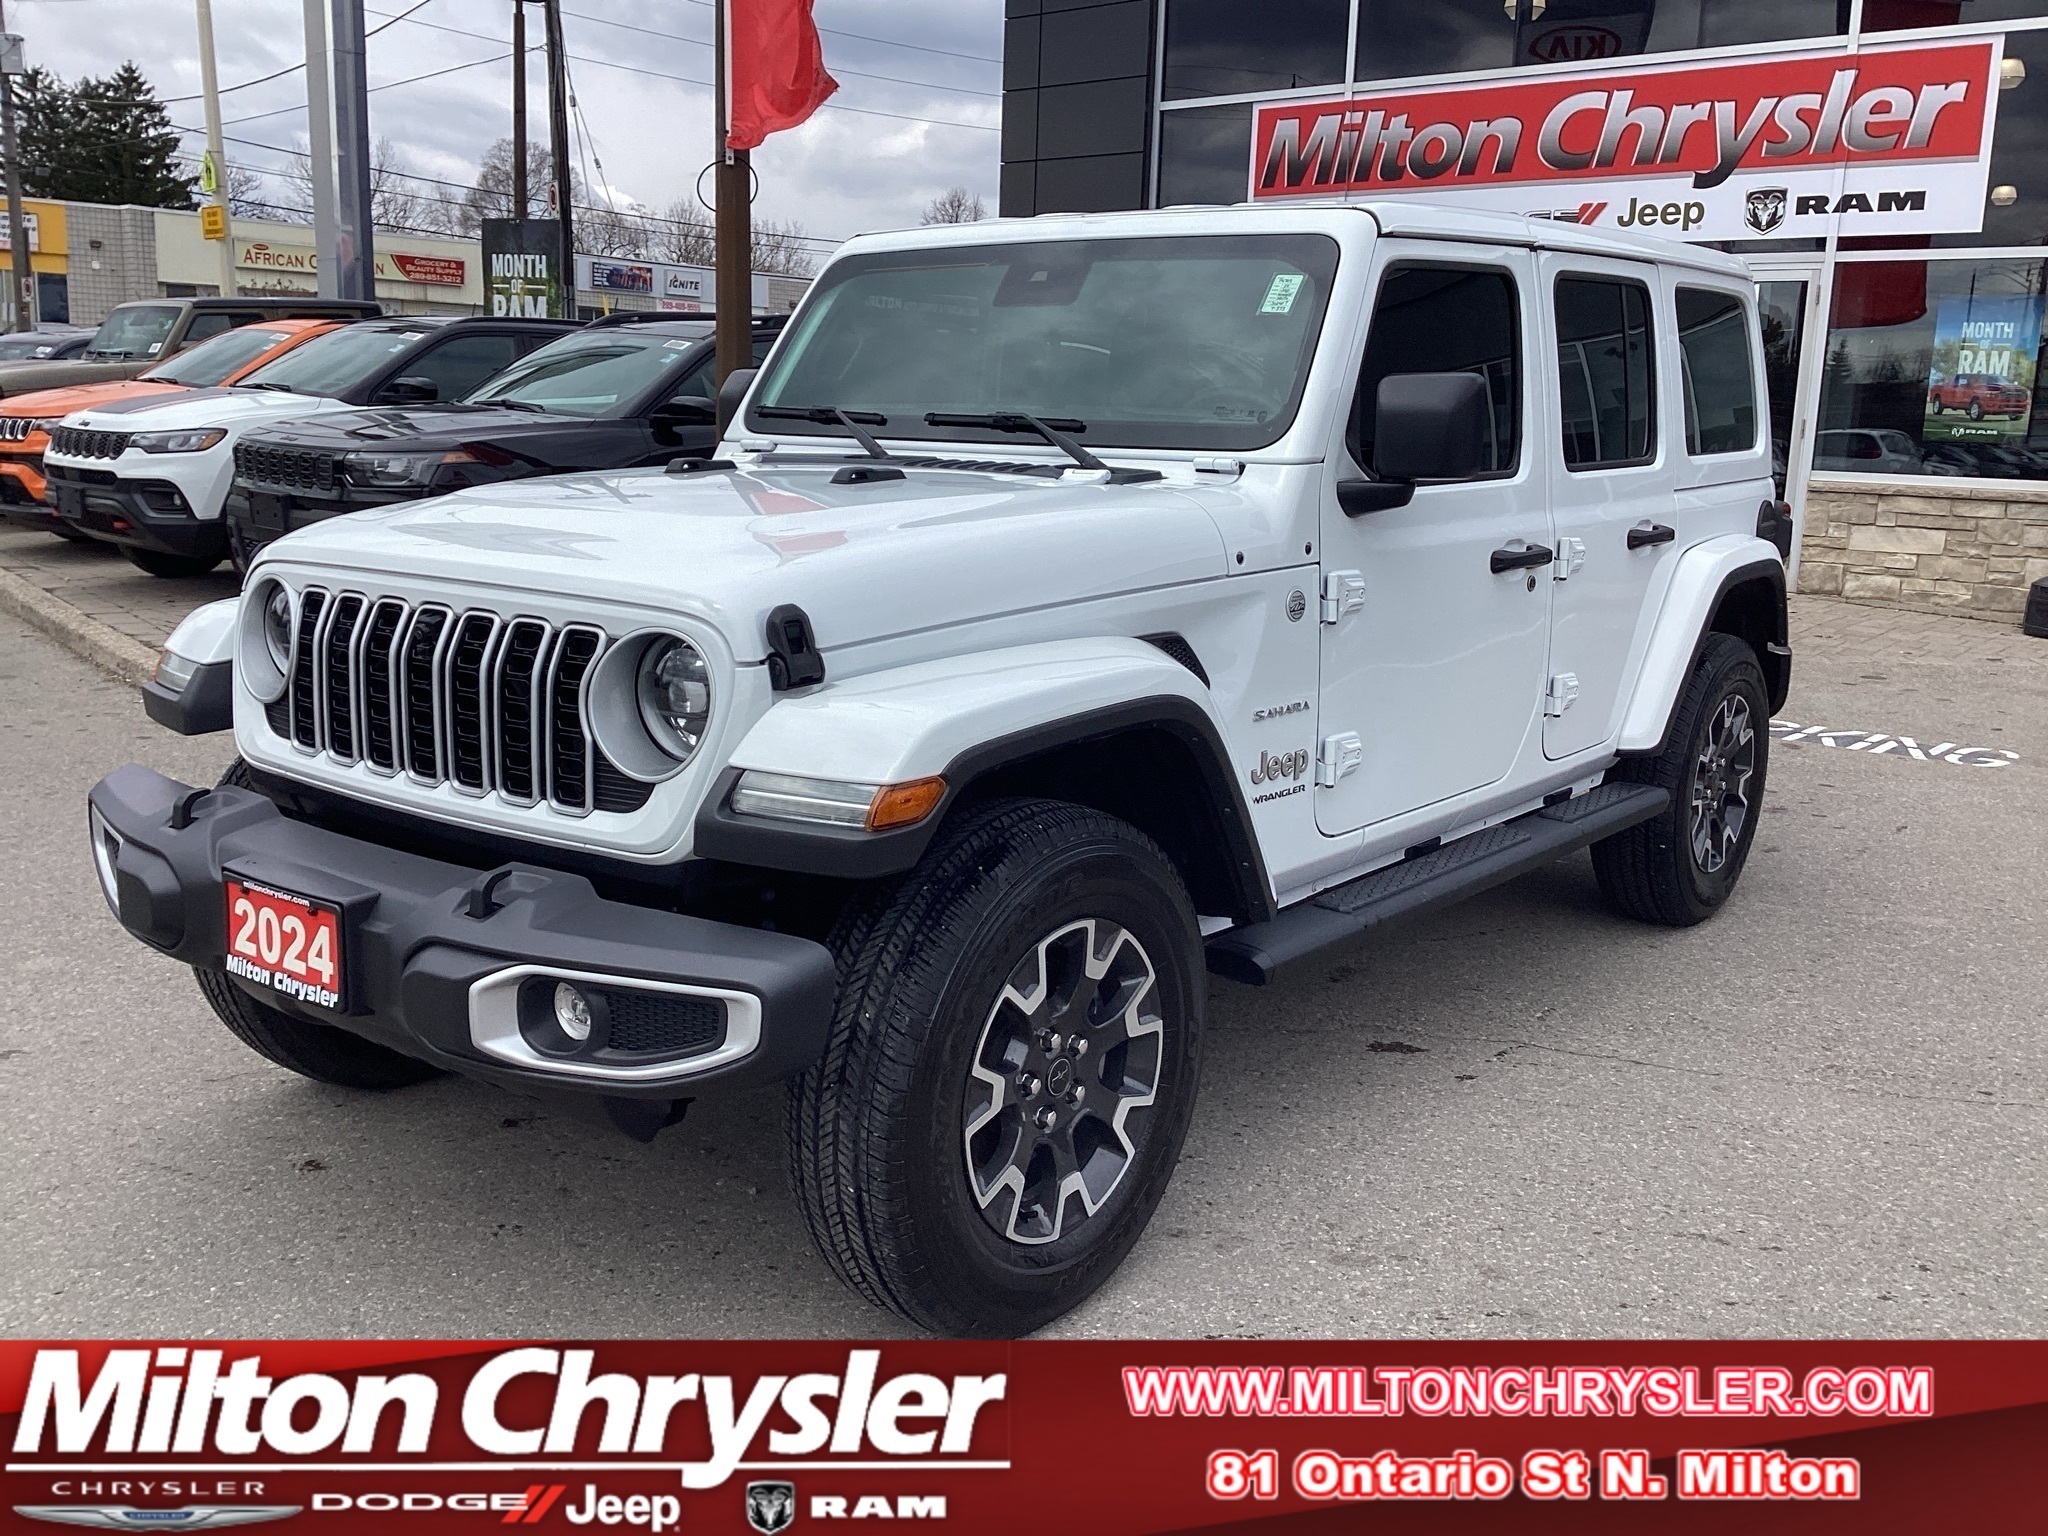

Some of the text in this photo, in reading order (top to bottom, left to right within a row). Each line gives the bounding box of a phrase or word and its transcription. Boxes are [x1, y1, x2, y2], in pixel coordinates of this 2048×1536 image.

[1260, 68, 1968, 189] Milton Chrysler
[1617, 197, 1705, 231] Jeep
[1795, 190, 1927, 215] RAM
[243, 248, 304, 269] AFRICAN
[405, 264, 462, 275] BEAUTY SUPPLY
[414, 258, 449, 267] GROCERY
[492, 253, 547, 278] MONTH
[510, 278, 523, 293] OF
[668, 277, 700, 291] IGNITE
[1961, 321, 2014, 339] MONTH
[1979, 339, 1992, 350] OF
[1957, 350, 2011, 377] RAM
[1965, 428, 1998, 436] RAM
[1252, 699, 1310, 723] SAHARA
[1250, 748, 1309, 785] Jeep
[1251, 783, 1306, 805] WRANGLER
[234, 898, 334, 985] 2024
[226, 953, 339, 1009] Milton Chrysler
